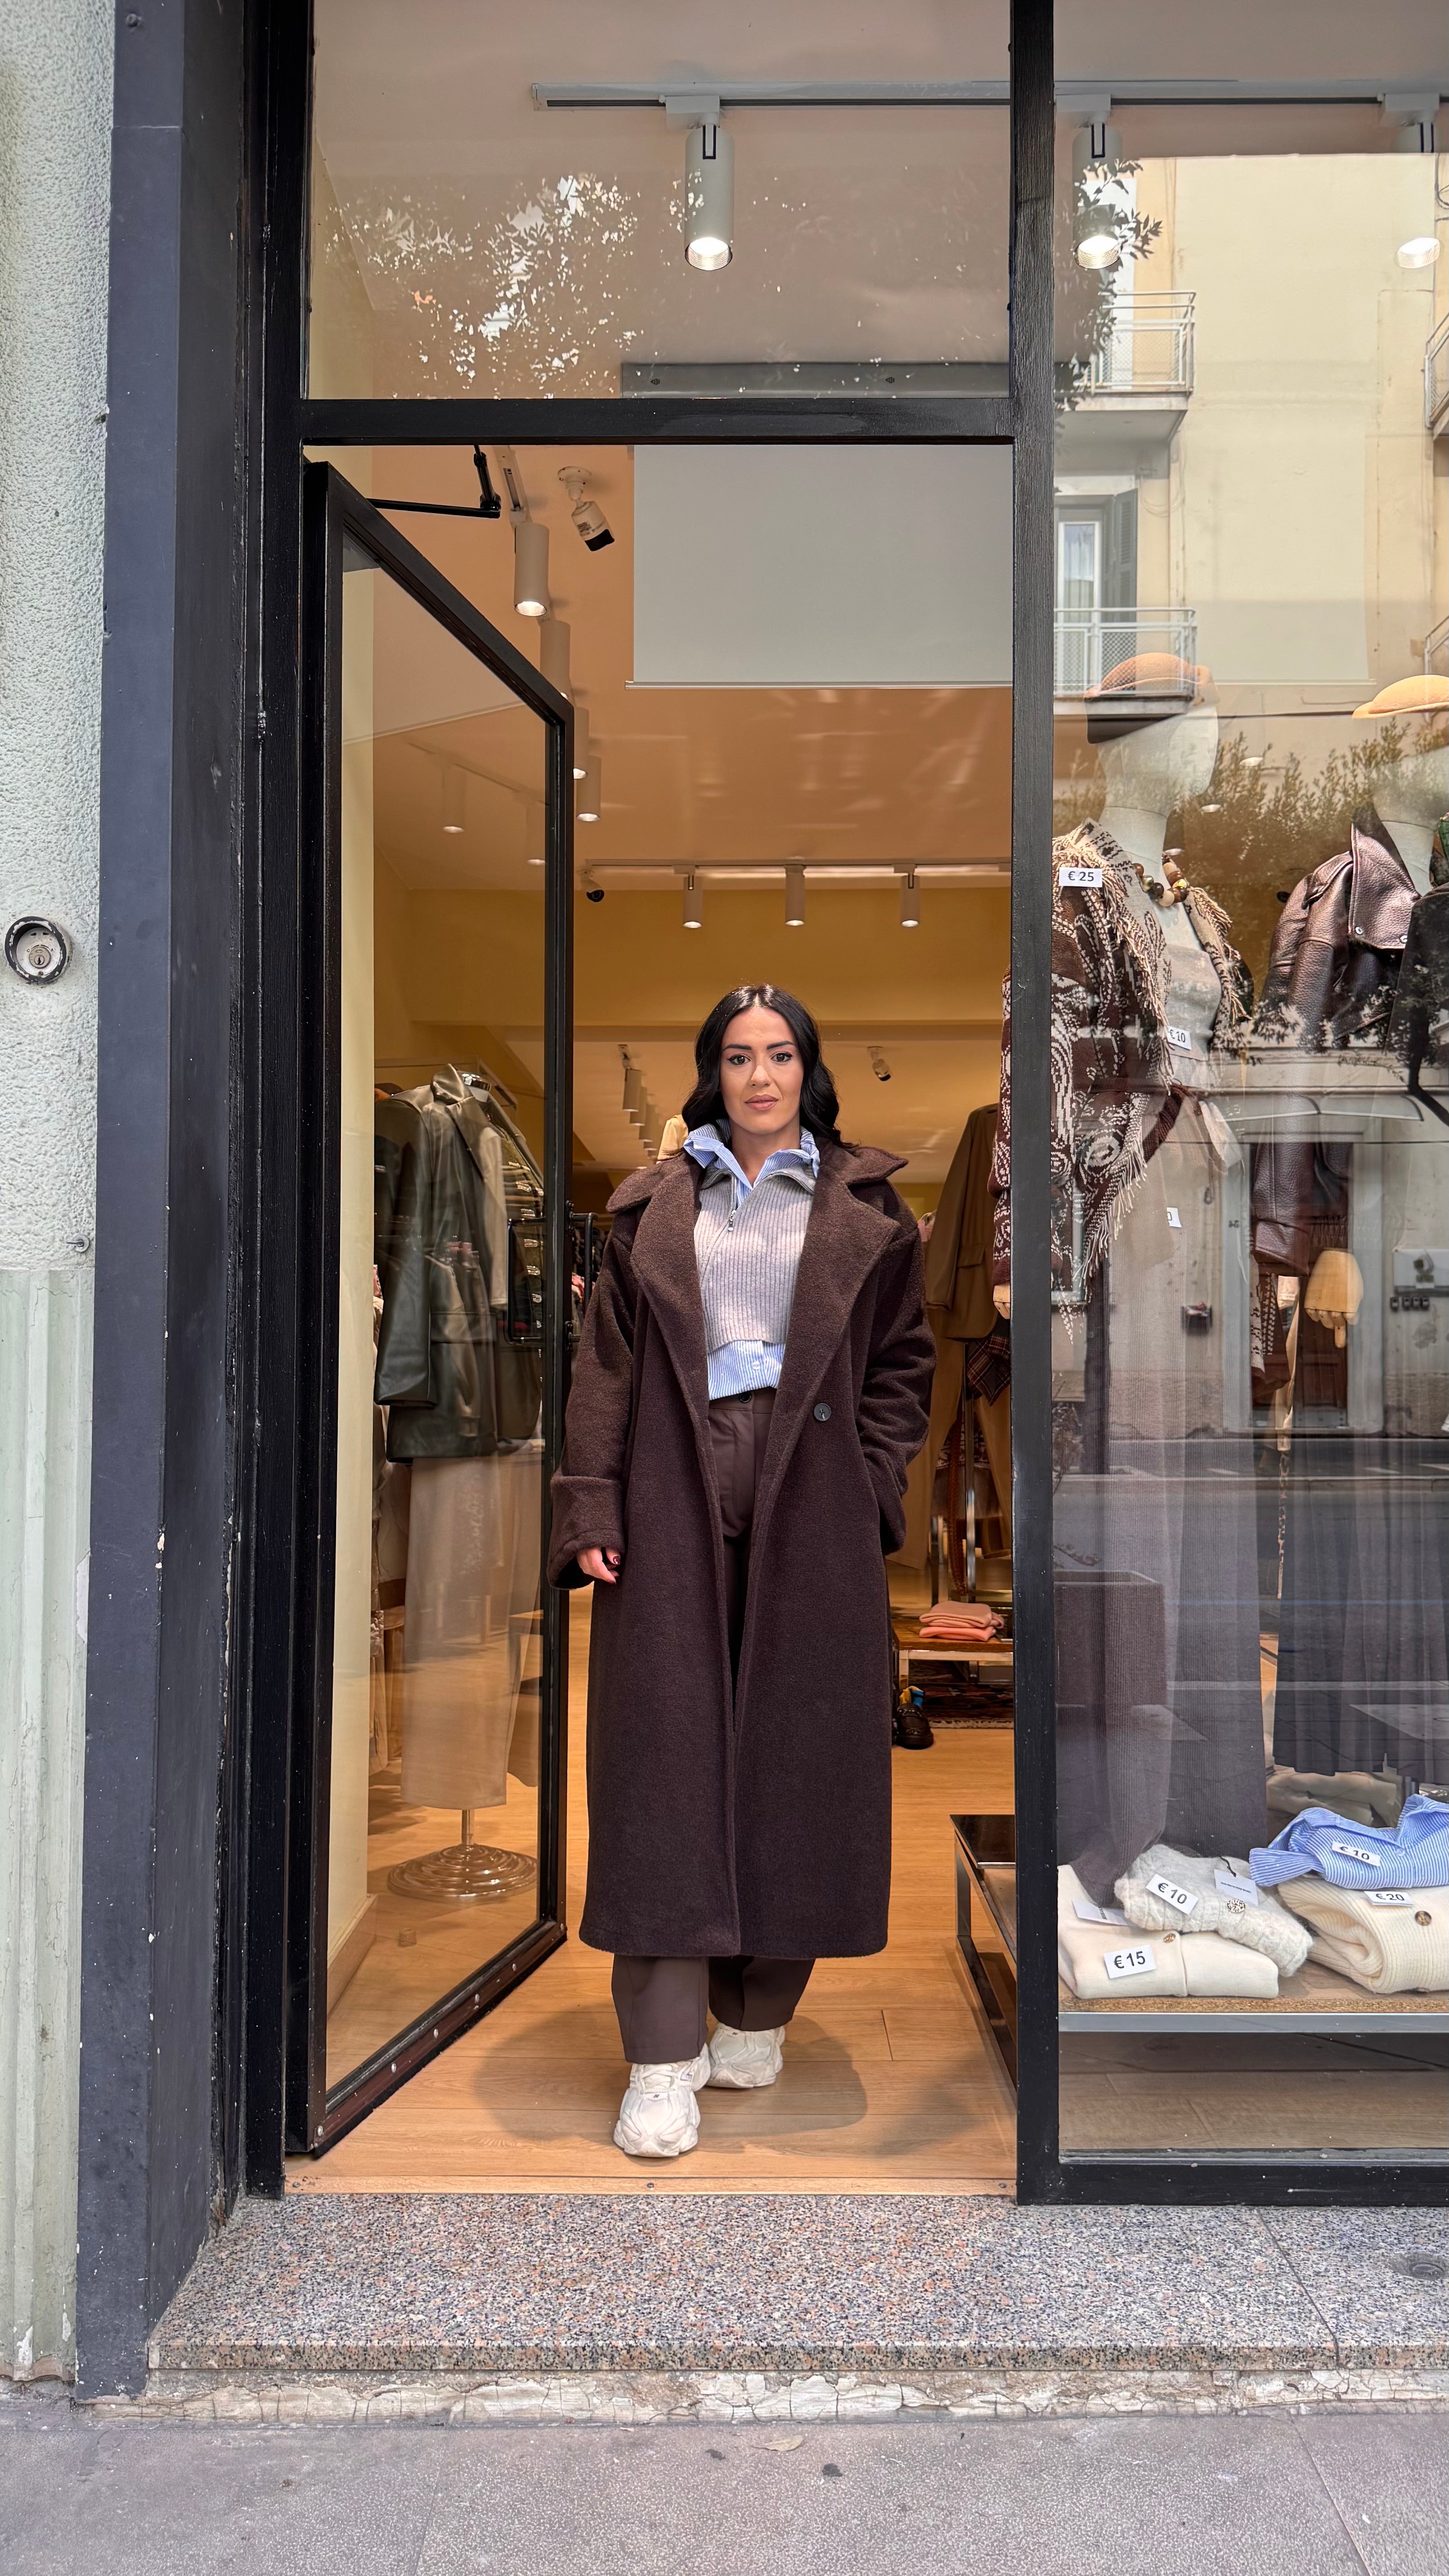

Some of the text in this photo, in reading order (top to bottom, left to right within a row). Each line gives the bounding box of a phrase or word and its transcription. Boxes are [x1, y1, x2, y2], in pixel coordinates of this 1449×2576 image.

[1068, 871, 1094, 881] € 25
[1176, 1031, 1186, 1043] 10
[1353, 1850, 1369, 1859] 10
[1158, 1882, 1187, 1904] € 10
[1113, 1950, 1145, 1969] € 15
